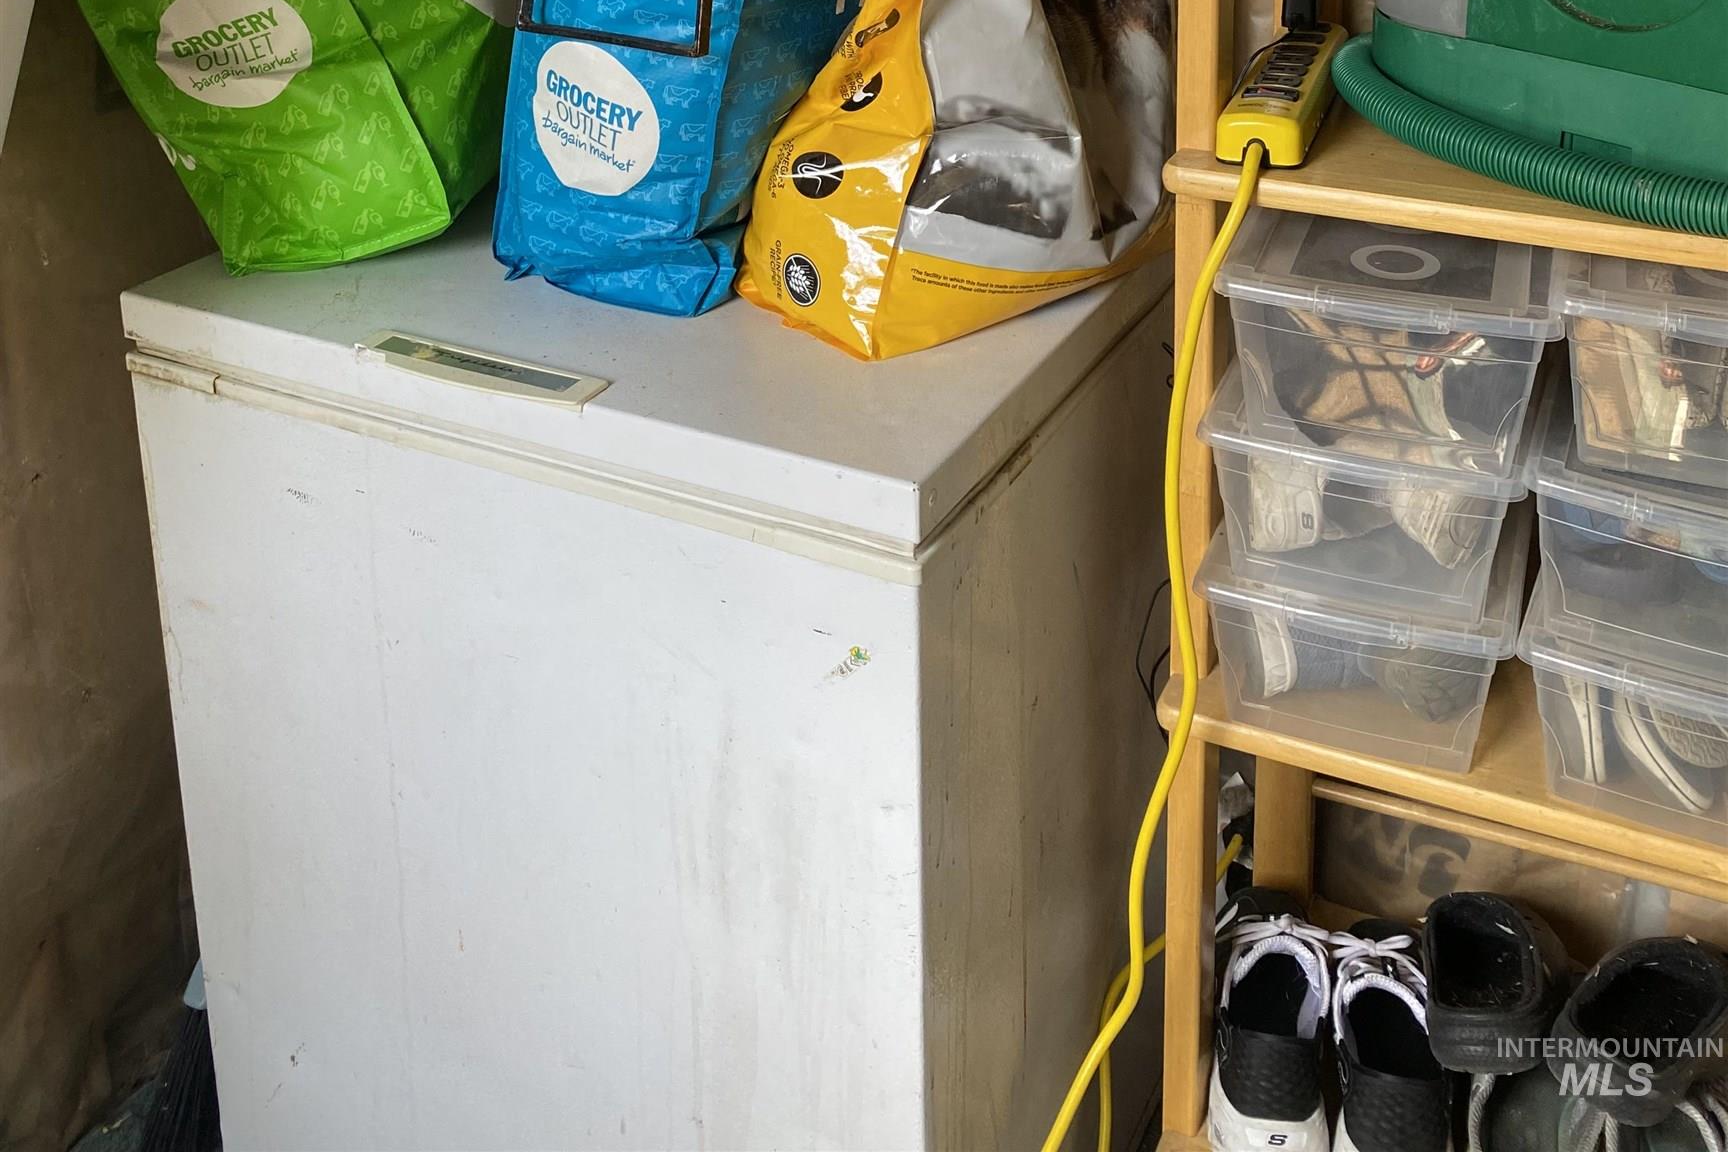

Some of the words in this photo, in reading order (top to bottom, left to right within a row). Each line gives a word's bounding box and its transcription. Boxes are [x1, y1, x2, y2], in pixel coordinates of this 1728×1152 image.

[171, 7, 279, 58] GROCERY
[196, 32, 274, 71] OUTLET
[188, 65, 246, 91] bargain
[250, 48, 299, 74] market
[546, 69, 643, 133] GROCERY
[556, 100, 622, 152] OUTLET
[541, 109, 588, 152] bargain
[589, 142, 636, 173] market
